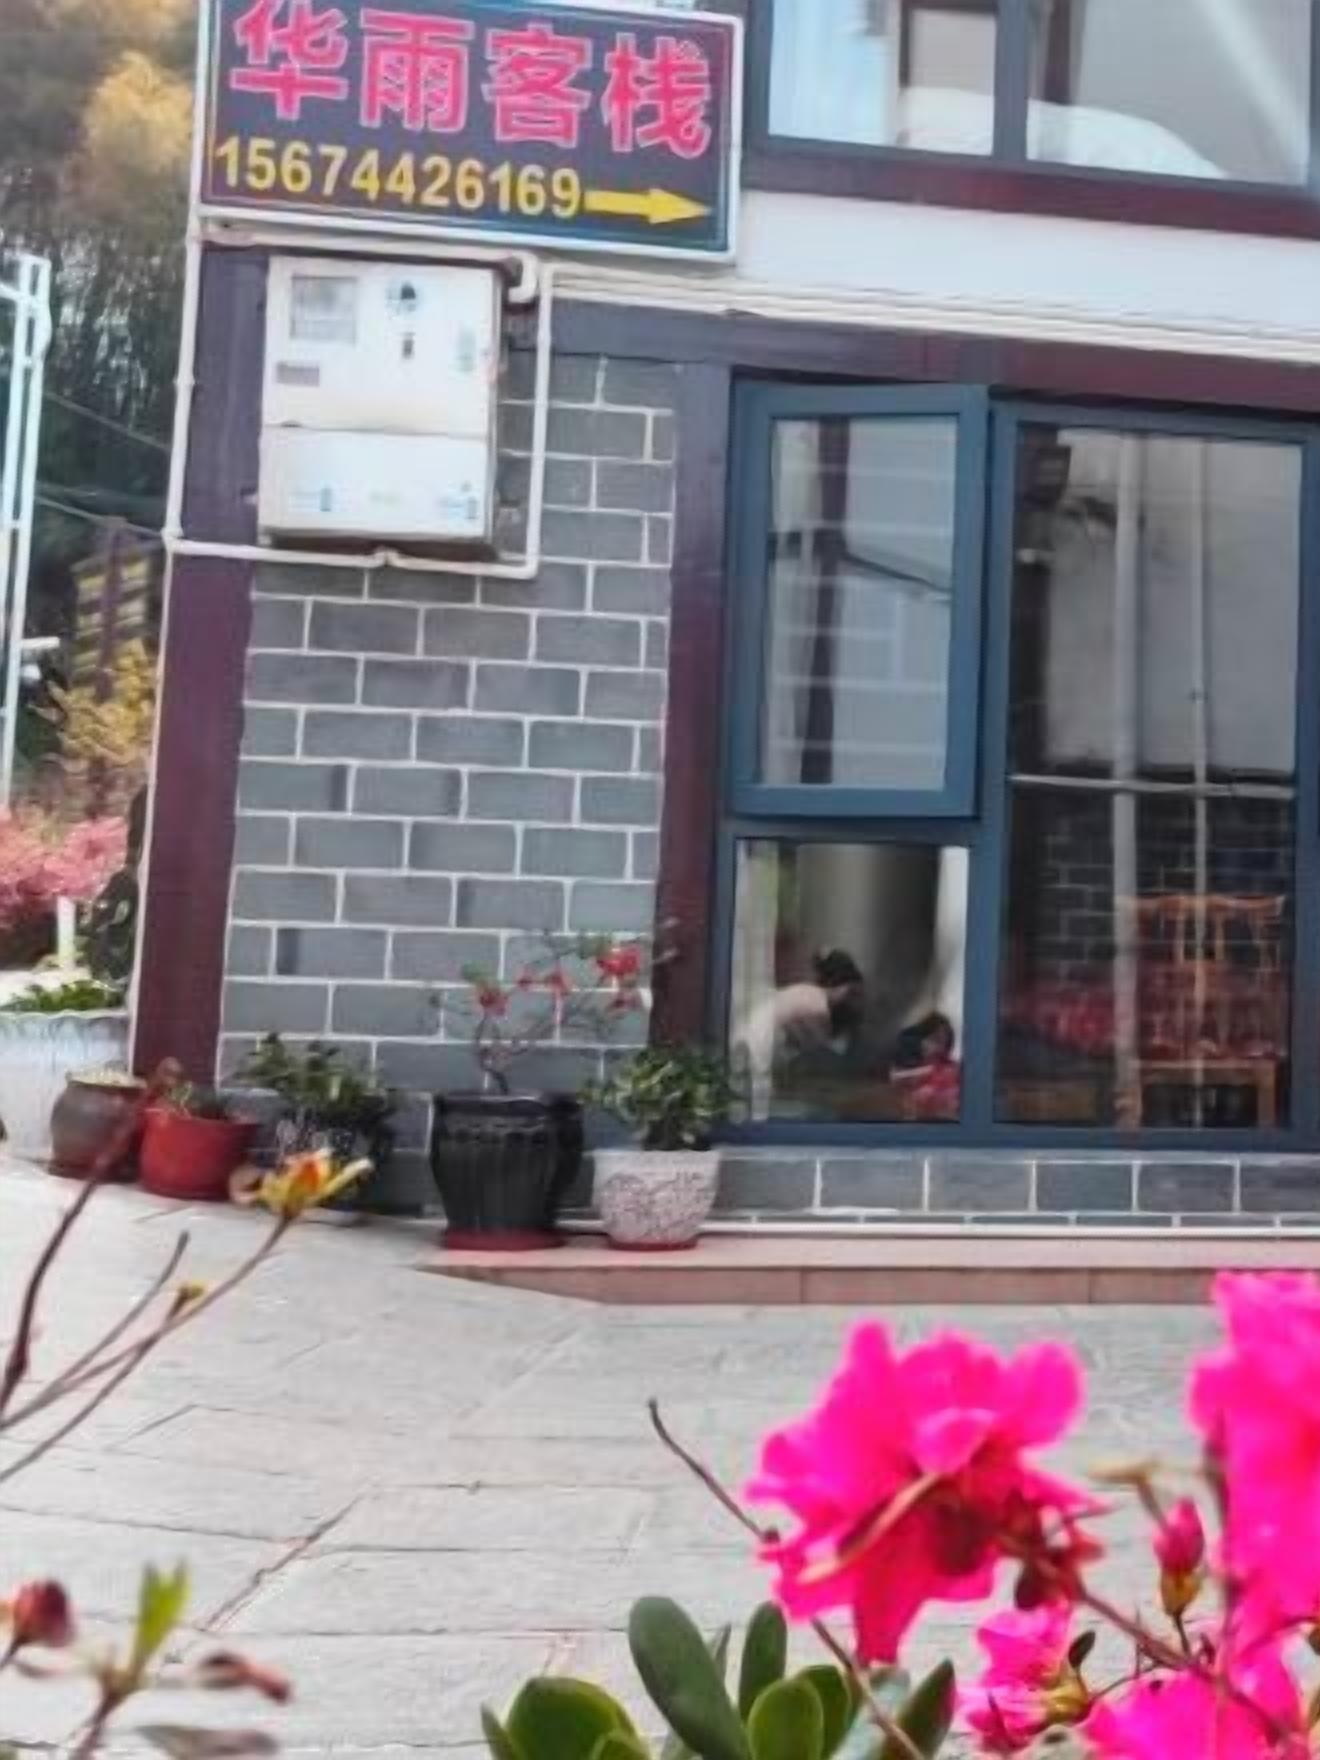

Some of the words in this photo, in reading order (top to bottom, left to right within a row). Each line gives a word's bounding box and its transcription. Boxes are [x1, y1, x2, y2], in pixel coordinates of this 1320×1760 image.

[229, 0, 712, 158] 华雨客栈
[214, 135, 582, 218] 15674426169
